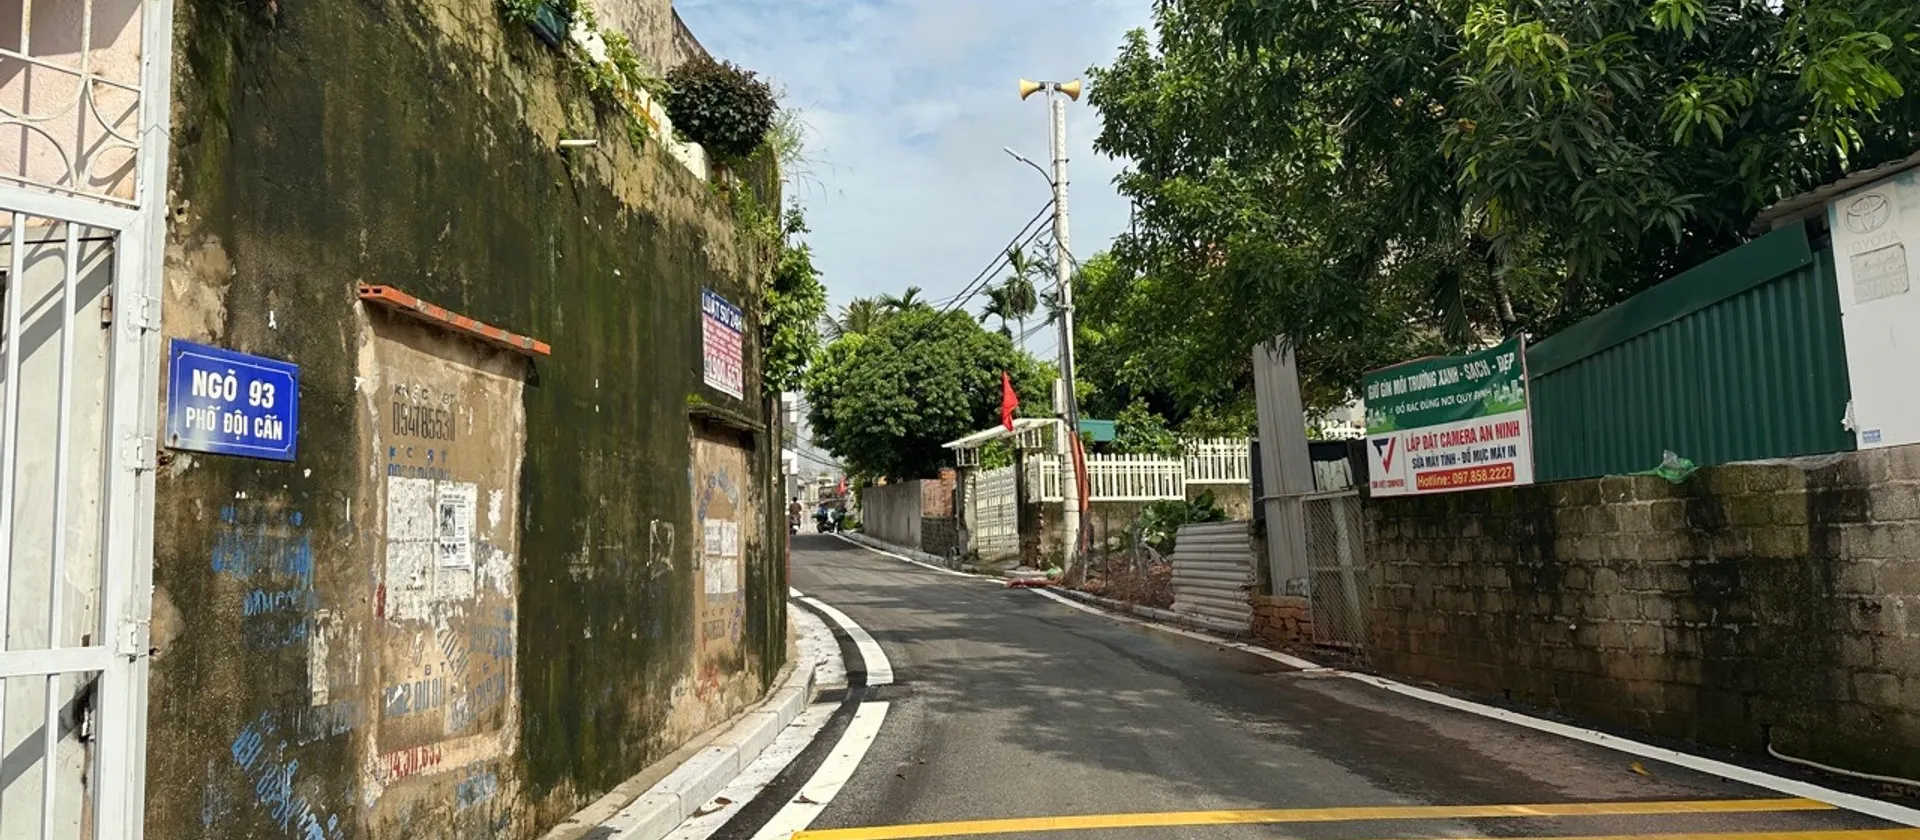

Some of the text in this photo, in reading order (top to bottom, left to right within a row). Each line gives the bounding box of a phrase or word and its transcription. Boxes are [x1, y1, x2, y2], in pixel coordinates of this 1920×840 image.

[1438, 366, 1460, 386] XANH
[1463, 359, 1491, 382] SẠCH
[1495, 352, 1515, 375] ĐẸP
[192, 369, 275, 408] NGÕ 93
[1456, 391, 1472, 404] QUY
[186, 405, 283, 441] PHỐ ĐỘI CẤN
[1440, 427, 1477, 448] CAMERA
[1480, 424, 1493, 442] AN
[1495, 420, 1520, 439] NINH
[1507, 445, 1516, 457] IN
[1417, 474, 1450, 487] Hotline:
